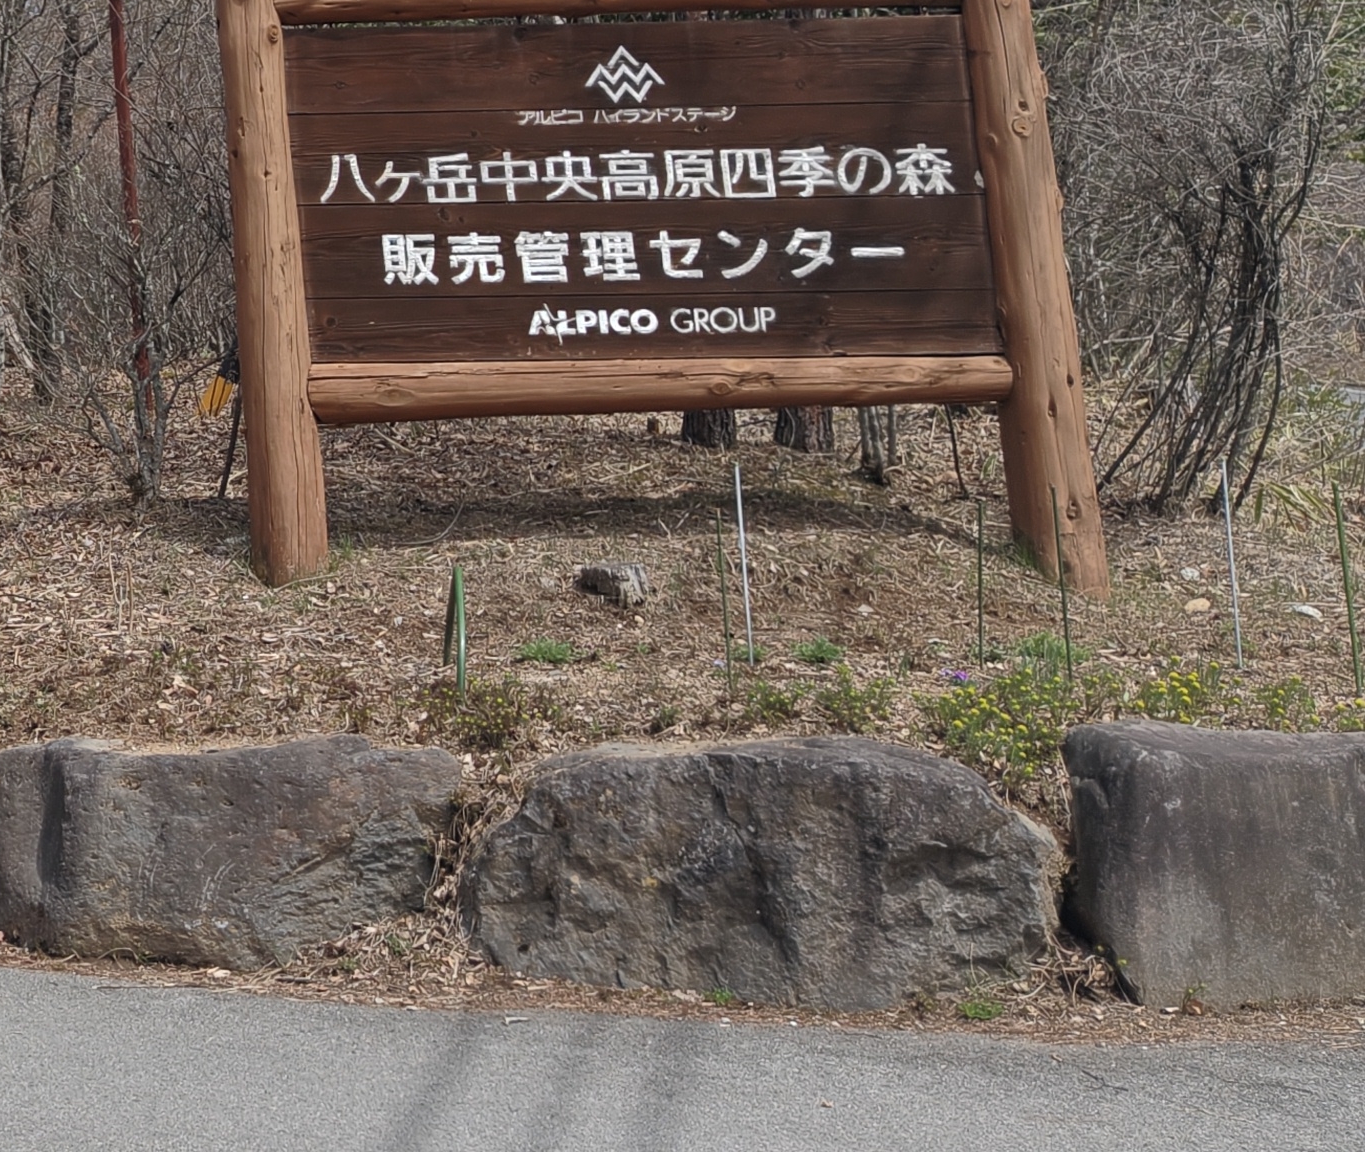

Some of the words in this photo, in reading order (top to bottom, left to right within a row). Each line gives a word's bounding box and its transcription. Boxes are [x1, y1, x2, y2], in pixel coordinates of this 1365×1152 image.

[593, 105, 737, 124] ハイランドステージ
[380, 227, 906, 285] 販売管理センター
[527, 304, 660, 342] ALPICO
[669, 306, 777, 335] GROUP
